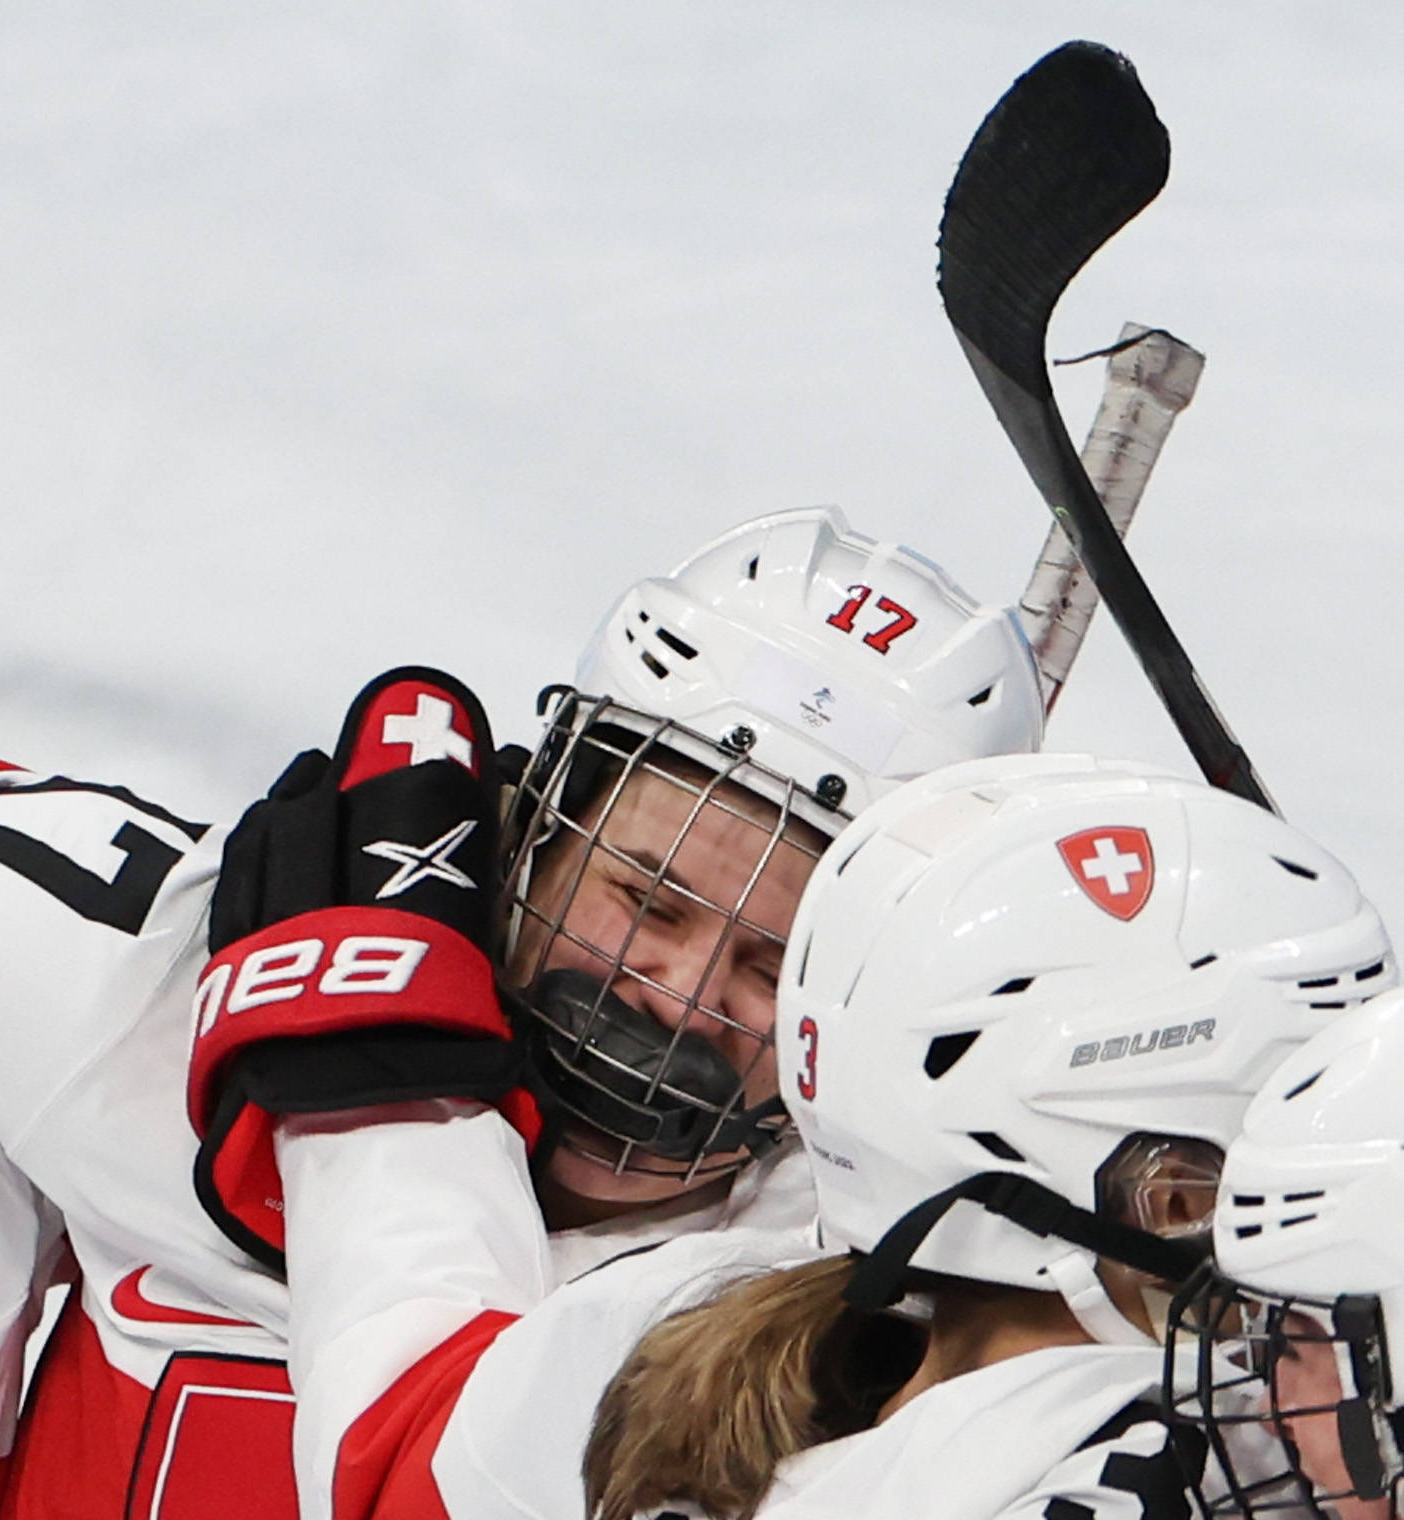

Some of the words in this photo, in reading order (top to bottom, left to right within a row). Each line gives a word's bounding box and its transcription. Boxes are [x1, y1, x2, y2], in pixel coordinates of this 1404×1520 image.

[825, 583, 918, 655] 17
[797, 1015, 819, 1102] 3
[1069, 1017, 1217, 1069] BAUER
